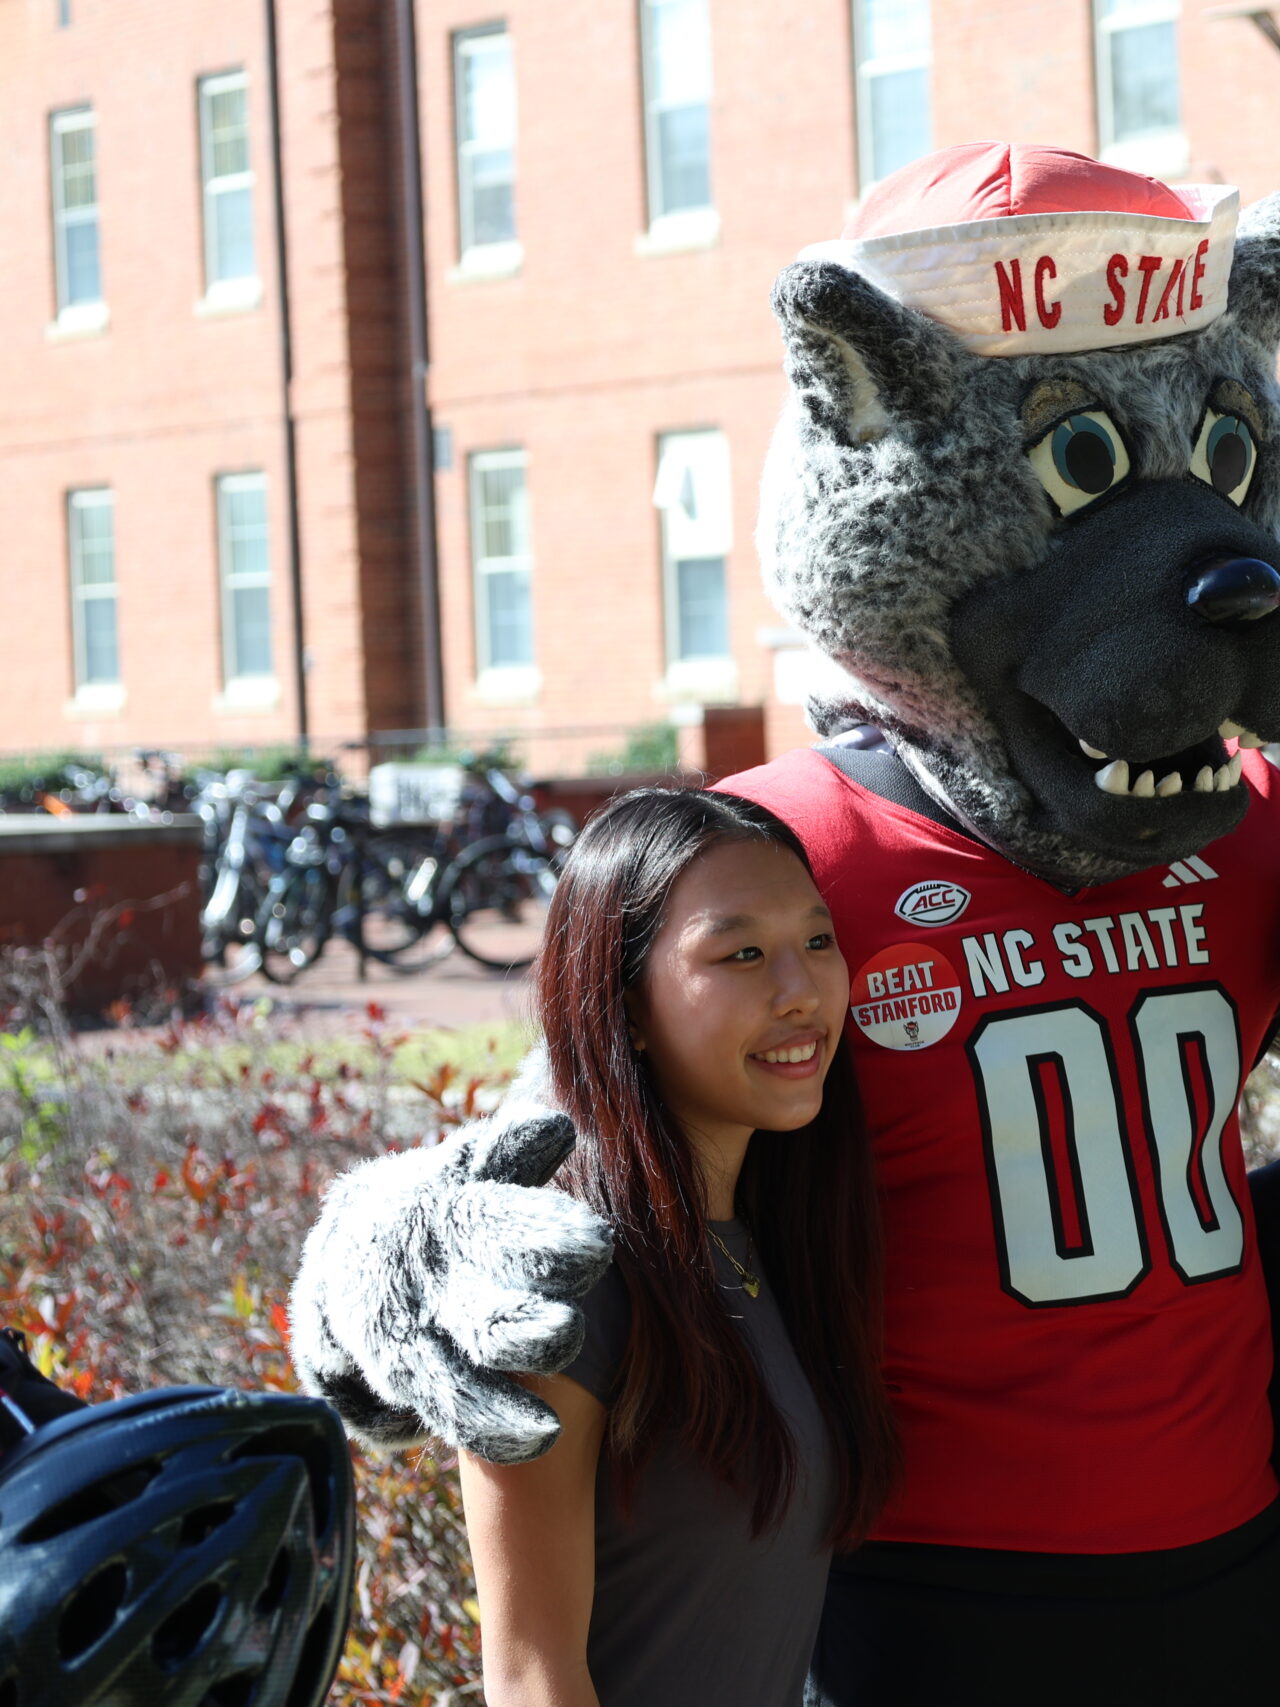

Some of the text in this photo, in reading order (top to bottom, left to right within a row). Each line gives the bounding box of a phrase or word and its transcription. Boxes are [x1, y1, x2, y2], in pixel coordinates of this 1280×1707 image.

[994, 256, 1062, 332] NC
[911, 889, 956, 912] ACC
[961, 903, 1210, 998] NC STATE
[866, 961, 934, 999] BEAT
[858, 991, 957, 1027] STANFORD
[964, 979, 1244, 1309] 00
